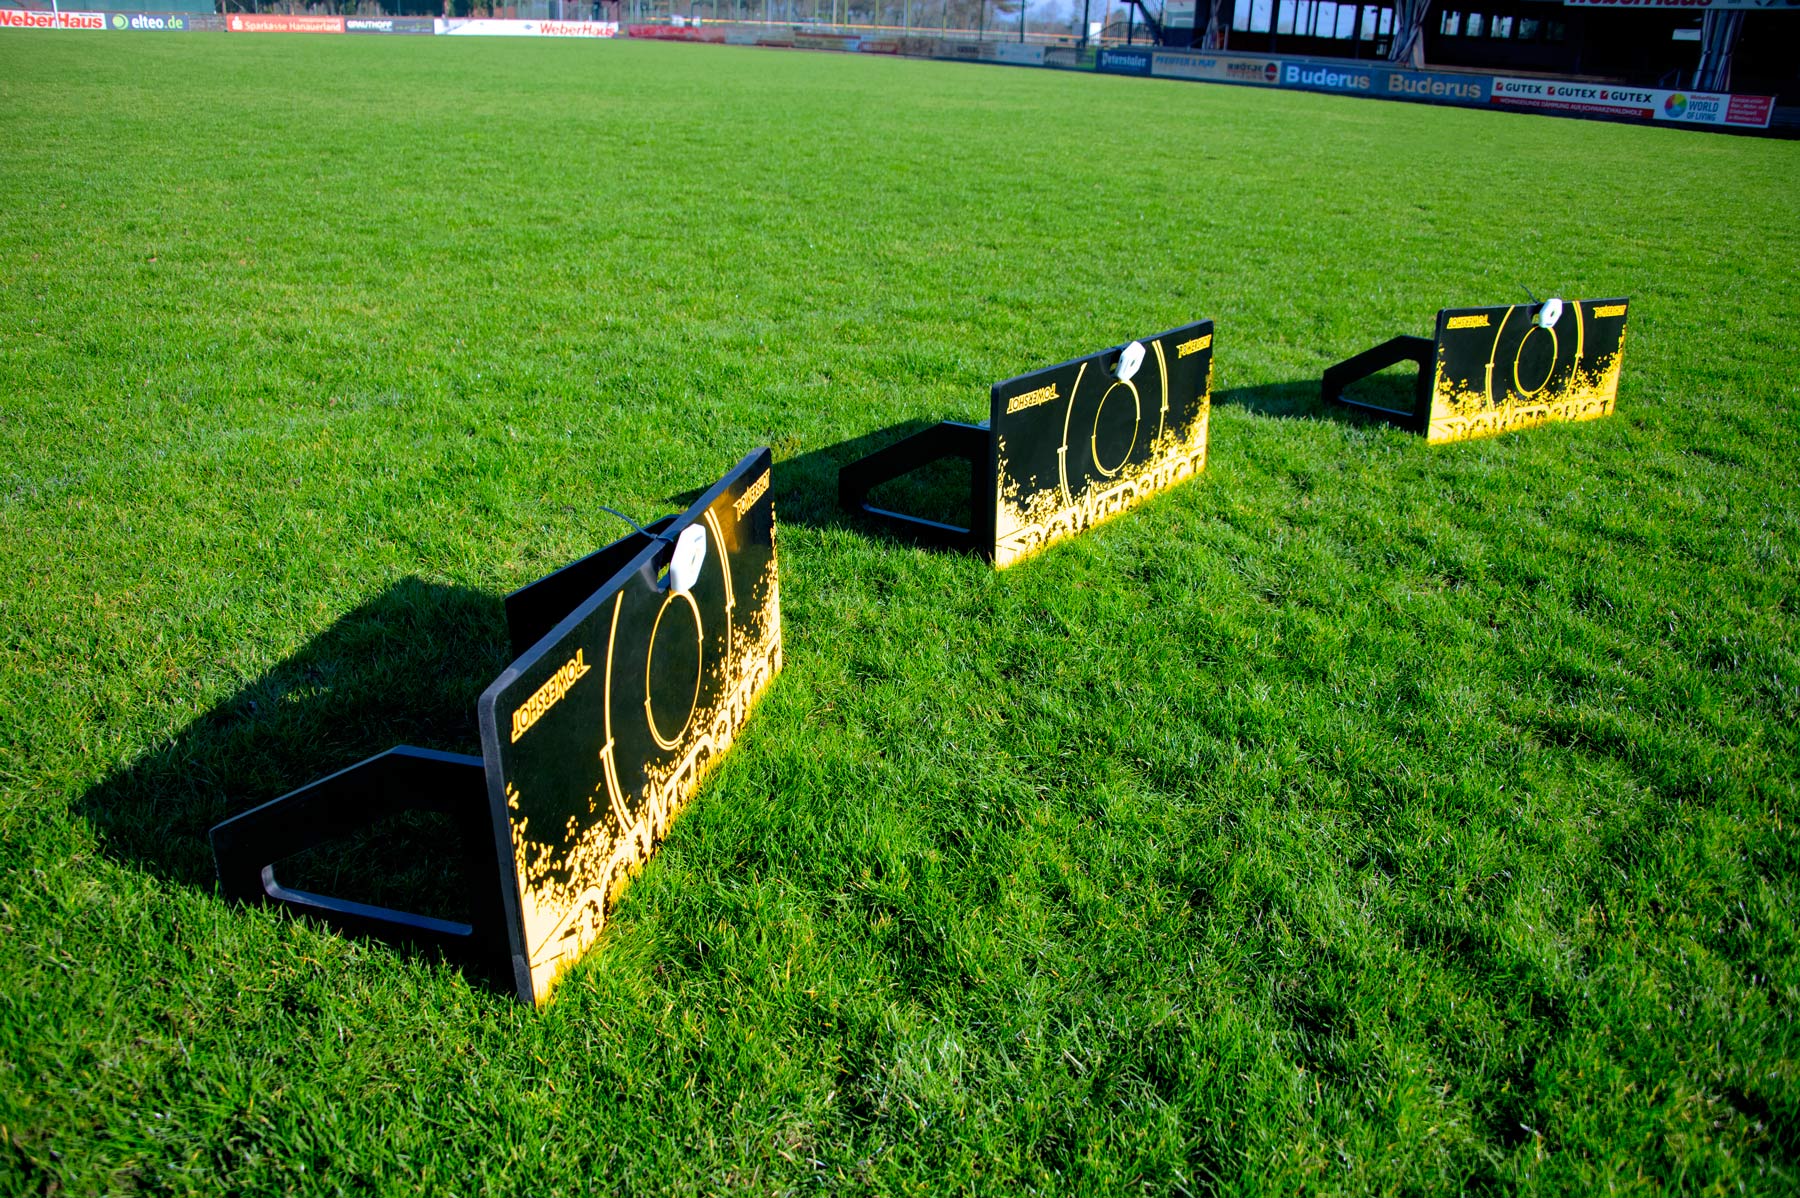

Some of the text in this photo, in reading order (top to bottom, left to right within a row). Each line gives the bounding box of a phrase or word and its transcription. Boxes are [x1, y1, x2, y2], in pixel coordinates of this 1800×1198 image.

[0, 10, 103, 29] WeberHaus
[131, 14, 183, 29] elteo.de
[540, 22, 615, 37] WeberHaus
[1286, 66, 1370, 89] Buderus
[1388, 73, 1482, 98] Buderus
[1505, 82, 1653, 104] GUTEX GUTEX GUTEX
[1688, 101, 1719, 113] WORLD
[1006, 383, 1060, 414] POWERSHOT
[732, 468, 770, 522] POWERSHOT
[511, 648, 591, 743] POWERSHOT
